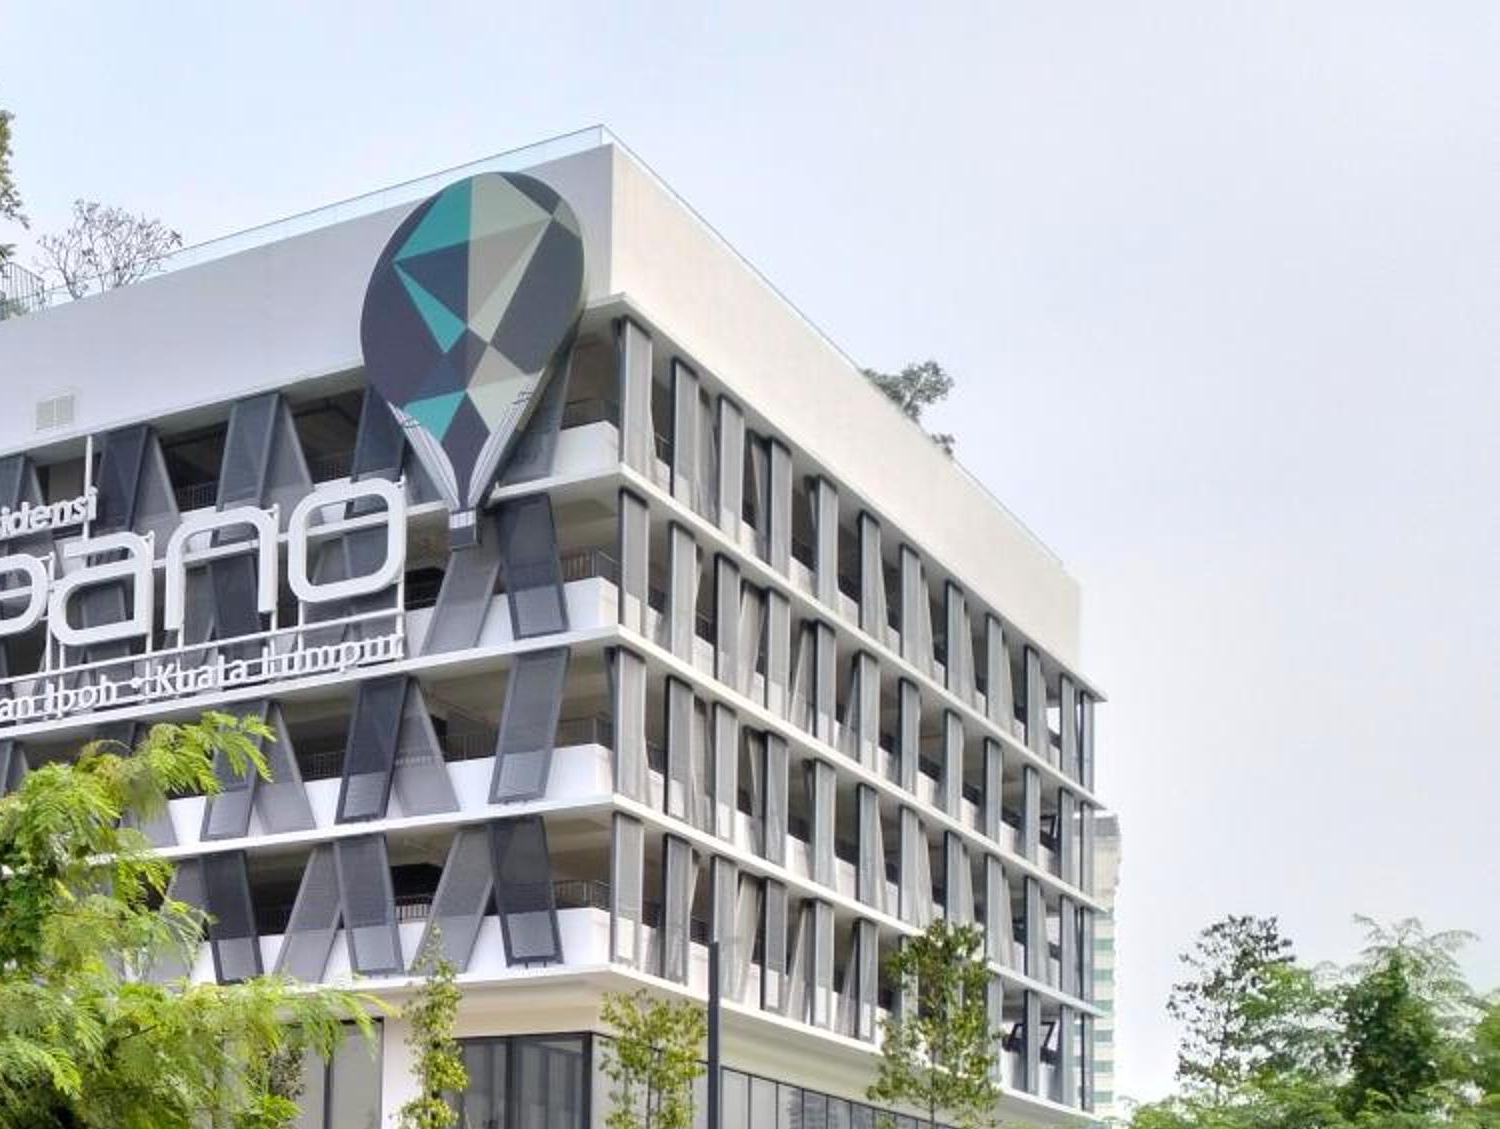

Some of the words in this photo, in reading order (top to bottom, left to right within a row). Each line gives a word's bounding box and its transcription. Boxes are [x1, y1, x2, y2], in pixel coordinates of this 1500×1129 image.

[43, 672, 117, 718] Ipoh
[155, 654, 248, 696] Kuala
[261, 634, 404, 678] Lumpur
